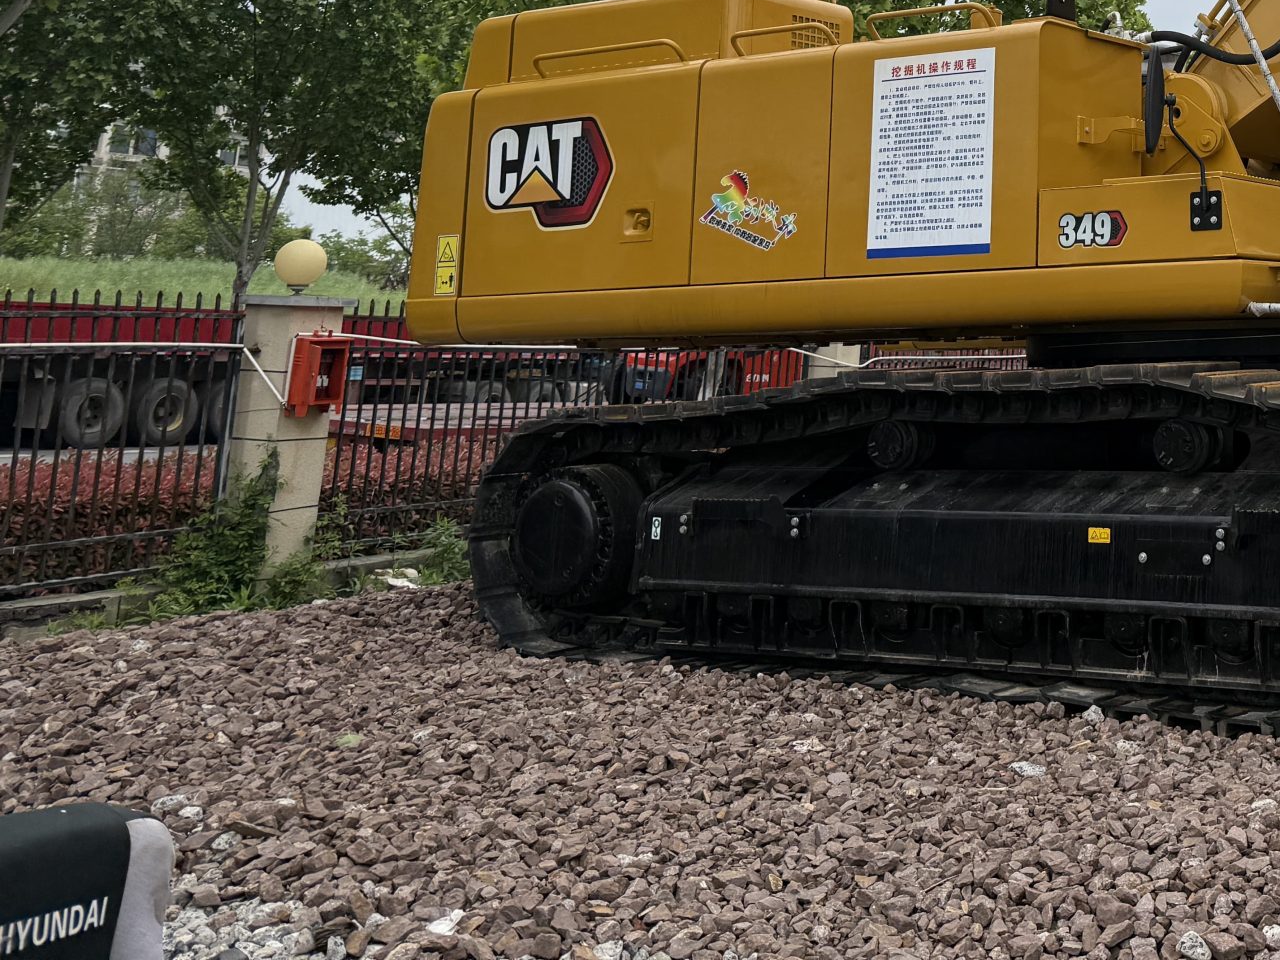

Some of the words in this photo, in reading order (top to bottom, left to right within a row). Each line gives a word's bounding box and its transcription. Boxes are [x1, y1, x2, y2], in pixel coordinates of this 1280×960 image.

[891, 58, 977, 78] 挖掘机操作规程
[487, 121, 583, 207] CAT
[1059, 212, 1112, 246] 349
[0, 896, 109, 955] HYUNDAI
